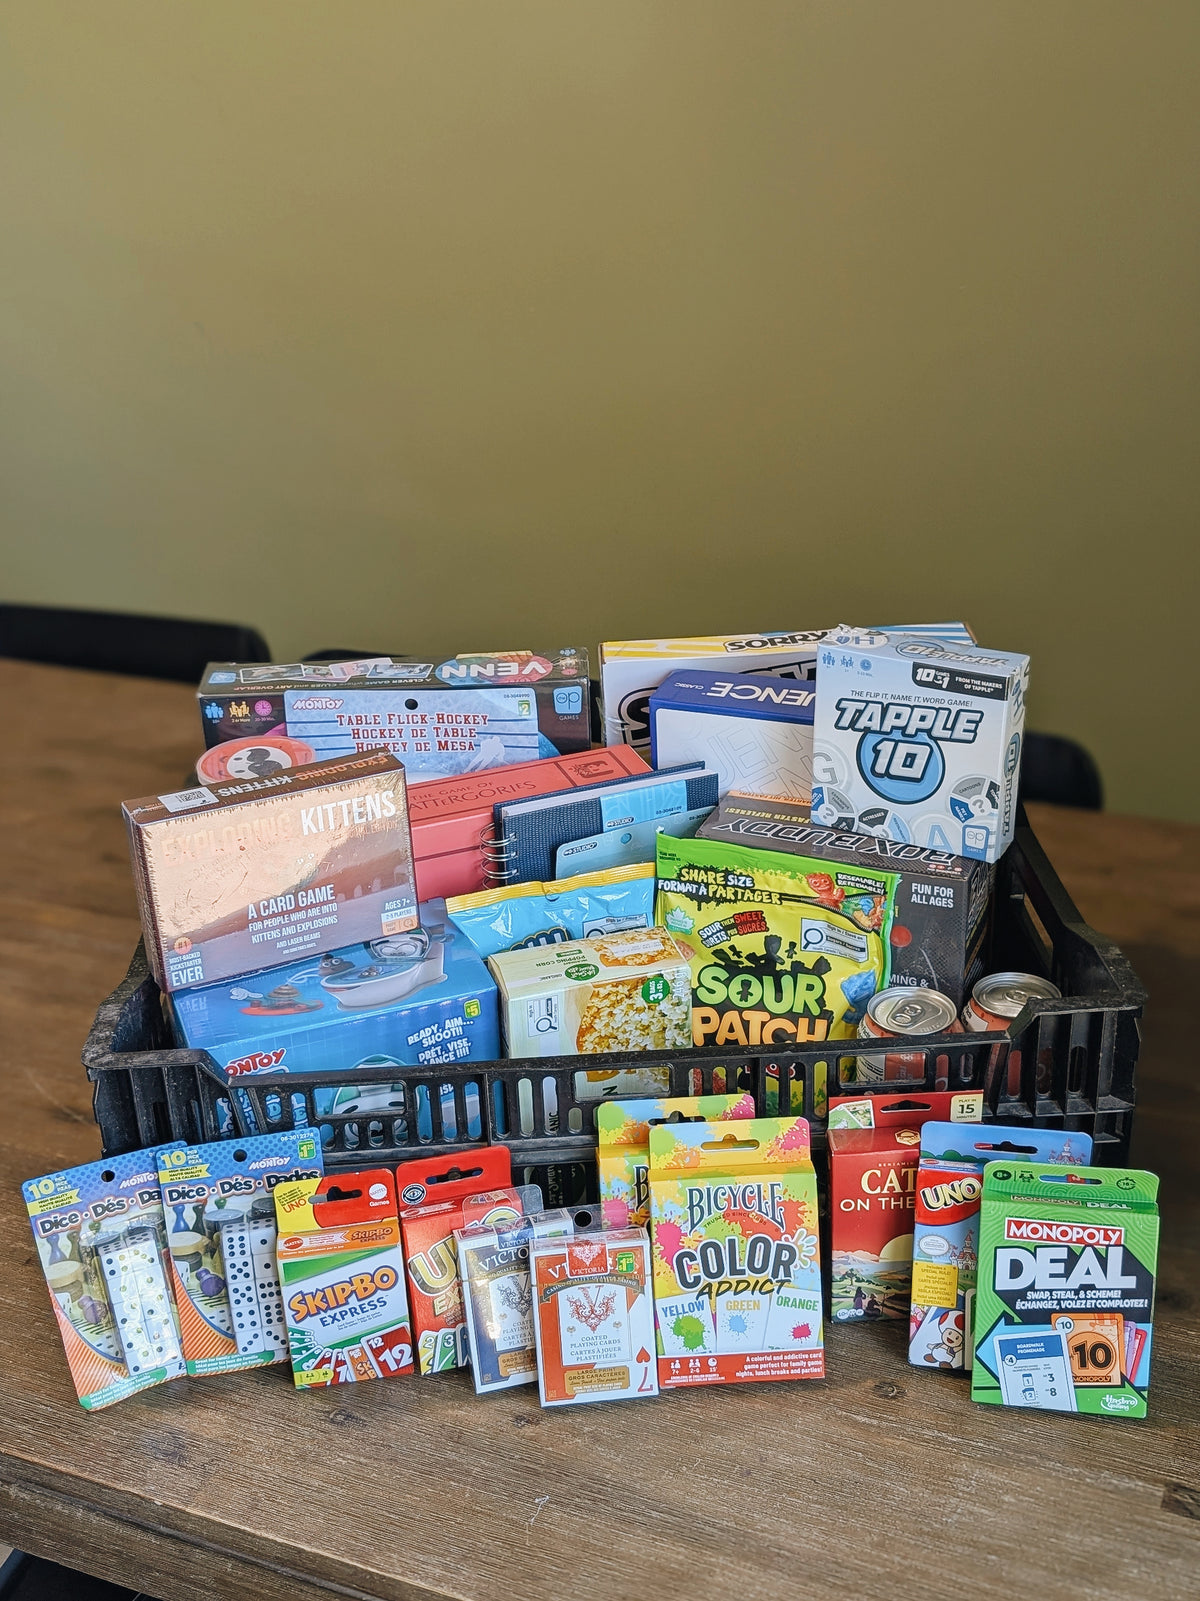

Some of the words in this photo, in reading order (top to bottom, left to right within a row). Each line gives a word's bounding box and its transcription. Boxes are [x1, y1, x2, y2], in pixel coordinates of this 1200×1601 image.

[726, 631, 828, 651] SORRY
[441, 662, 548, 678] VENN
[981, 680, 1003, 689] MAKERS
[292, 698, 345, 710] MONTOY
[890, 694, 912, 702] NAME
[922, 696, 945, 704] WORD
[947, 699, 973, 707] GAME!
[337, 714, 380, 726] TABLE
[387, 712, 489, 726] FLICK-HOCKEY
[835, 698, 984, 743] TAPPLE
[352, 728, 404, 739] HOCKEY
[411, 728, 427, 738] DE
[433, 727, 477, 737] TABLE
[355, 742, 408, 753] HOCKEY
[415, 742, 431, 751] DE
[437, 740, 475, 751] MESA
[295, 755, 389, 781] EXPLODING
[871, 738, 934, 782] 10
[218, 774, 292, 797] KITTENS
[412, 792, 432, 800] THE
[439, 786, 472, 795] GAME
[959, 782, 981, 794] CARTOONS
[409, 781, 536, 810] ATTERGORIES
[301, 790, 396, 836] KITTENS
[862, 812, 885, 822] ACTRESSES
[711, 818, 866, 851] BUDDY
[658, 880, 698, 893] FORMAT
[700, 883, 707, 895] À
[708, 885, 780, 904] PARTAGER
[911, 883, 932, 895] FUN
[933, 886, 953, 898] FOR
[248, 904, 257, 919] A
[260, 895, 295, 916] CARD
[298, 884, 335, 907] GAME
[385, 900, 401, 910] AGES
[911, 895, 928, 905] ALL
[928, 896, 954, 908] AGES
[249, 921, 262, 932] FOR
[264, 915, 289, 928] PEOPLE
[290, 911, 306, 921] WHO
[308, 907, 321, 918] ARE
[322, 903, 338, 913] INTO
[252, 929, 281, 944] KITTENS
[282, 926, 296, 936] AND
[297, 915, 337, 932] EXPLOSIONS
[288, 937, 303, 946] LASER
[304, 932, 320, 941] BEAMS
[169, 952, 201, 963] MOST-BACKED
[170, 958, 201, 971] KICKSTARTER
[556, 955, 585, 963] POPPING
[171, 966, 204, 987] EVER
[697, 966, 823, 1016] SOUR
[693, 1006, 828, 1047] PATCH
[407, 1024, 442, 1046] READY,
[447, 1038, 472, 1051] VISE,
[224, 1049, 285, 1076] ONTOY
[958, 1104, 975, 1114] 15
[161, 1151, 186, 1168] 10
[249, 1156, 291, 1171] MONTOY
[28, 1179, 54, 1199] 10
[167, 1186, 207, 1202] Dice
[219, 1175, 252, 1195] Dés
[861, 1169, 917, 1194] CAT
[921, 1178, 981, 1211] UNO
[283, 1198, 307, 1213] UNO
[686, 1182, 785, 1237] BICYCLE
[840, 1198, 870, 1212] ON
[878, 1197, 915, 1209] THE
[39, 1212, 80, 1234] Dice
[91, 1199, 126, 1218] Dés
[1009, 1222, 1121, 1244] MONOPOLY
[479, 1247, 528, 1271] VICTO
[673, 1235, 797, 1289] COLOR
[572, 1266, 604, 1275] VICTORIA
[995, 1246, 1137, 1290] DEAL
[289, 1265, 399, 1324] SKIP-BO
[696, 1279, 791, 1300] ADDICT
[1027, 1291, 1050, 1300] SWAP,
[1052, 1291, 1078, 1300] STEAL,
[1086, 1290, 1121, 1298] SCHEME!
[319, 1296, 387, 1327] EXPRESS
[662, 1300, 705, 1318] YELLOW
[726, 1300, 760, 1311] GREEN
[776, 1295, 819, 1312] ORANGE
[1016, 1299, 1060, 1310] ÉCHANGEZ,
[1061, 1300, 1085, 1308] VOLEZ
[1097, 1299, 1143, 1308] COMPLOTEZ
[1060, 1321, 1072, 1329] 10
[368, 1337, 384, 1348] 12
[424, 1337, 433, 1348] 2
[444, 1335, 454, 1348] 3
[581, 1334, 608, 1342] COATED
[379, 1344, 413, 1372] 12
[570, 1348, 595, 1356] CARTES
[1073, 1341, 1113, 1369] 10
[760, 1362, 780, 1370] perfect
[1047, 1373, 1055, 1383] 3
[1050, 1387, 1057, 1397] 8
[1102, 1394, 1136, 1406] Hasbro
